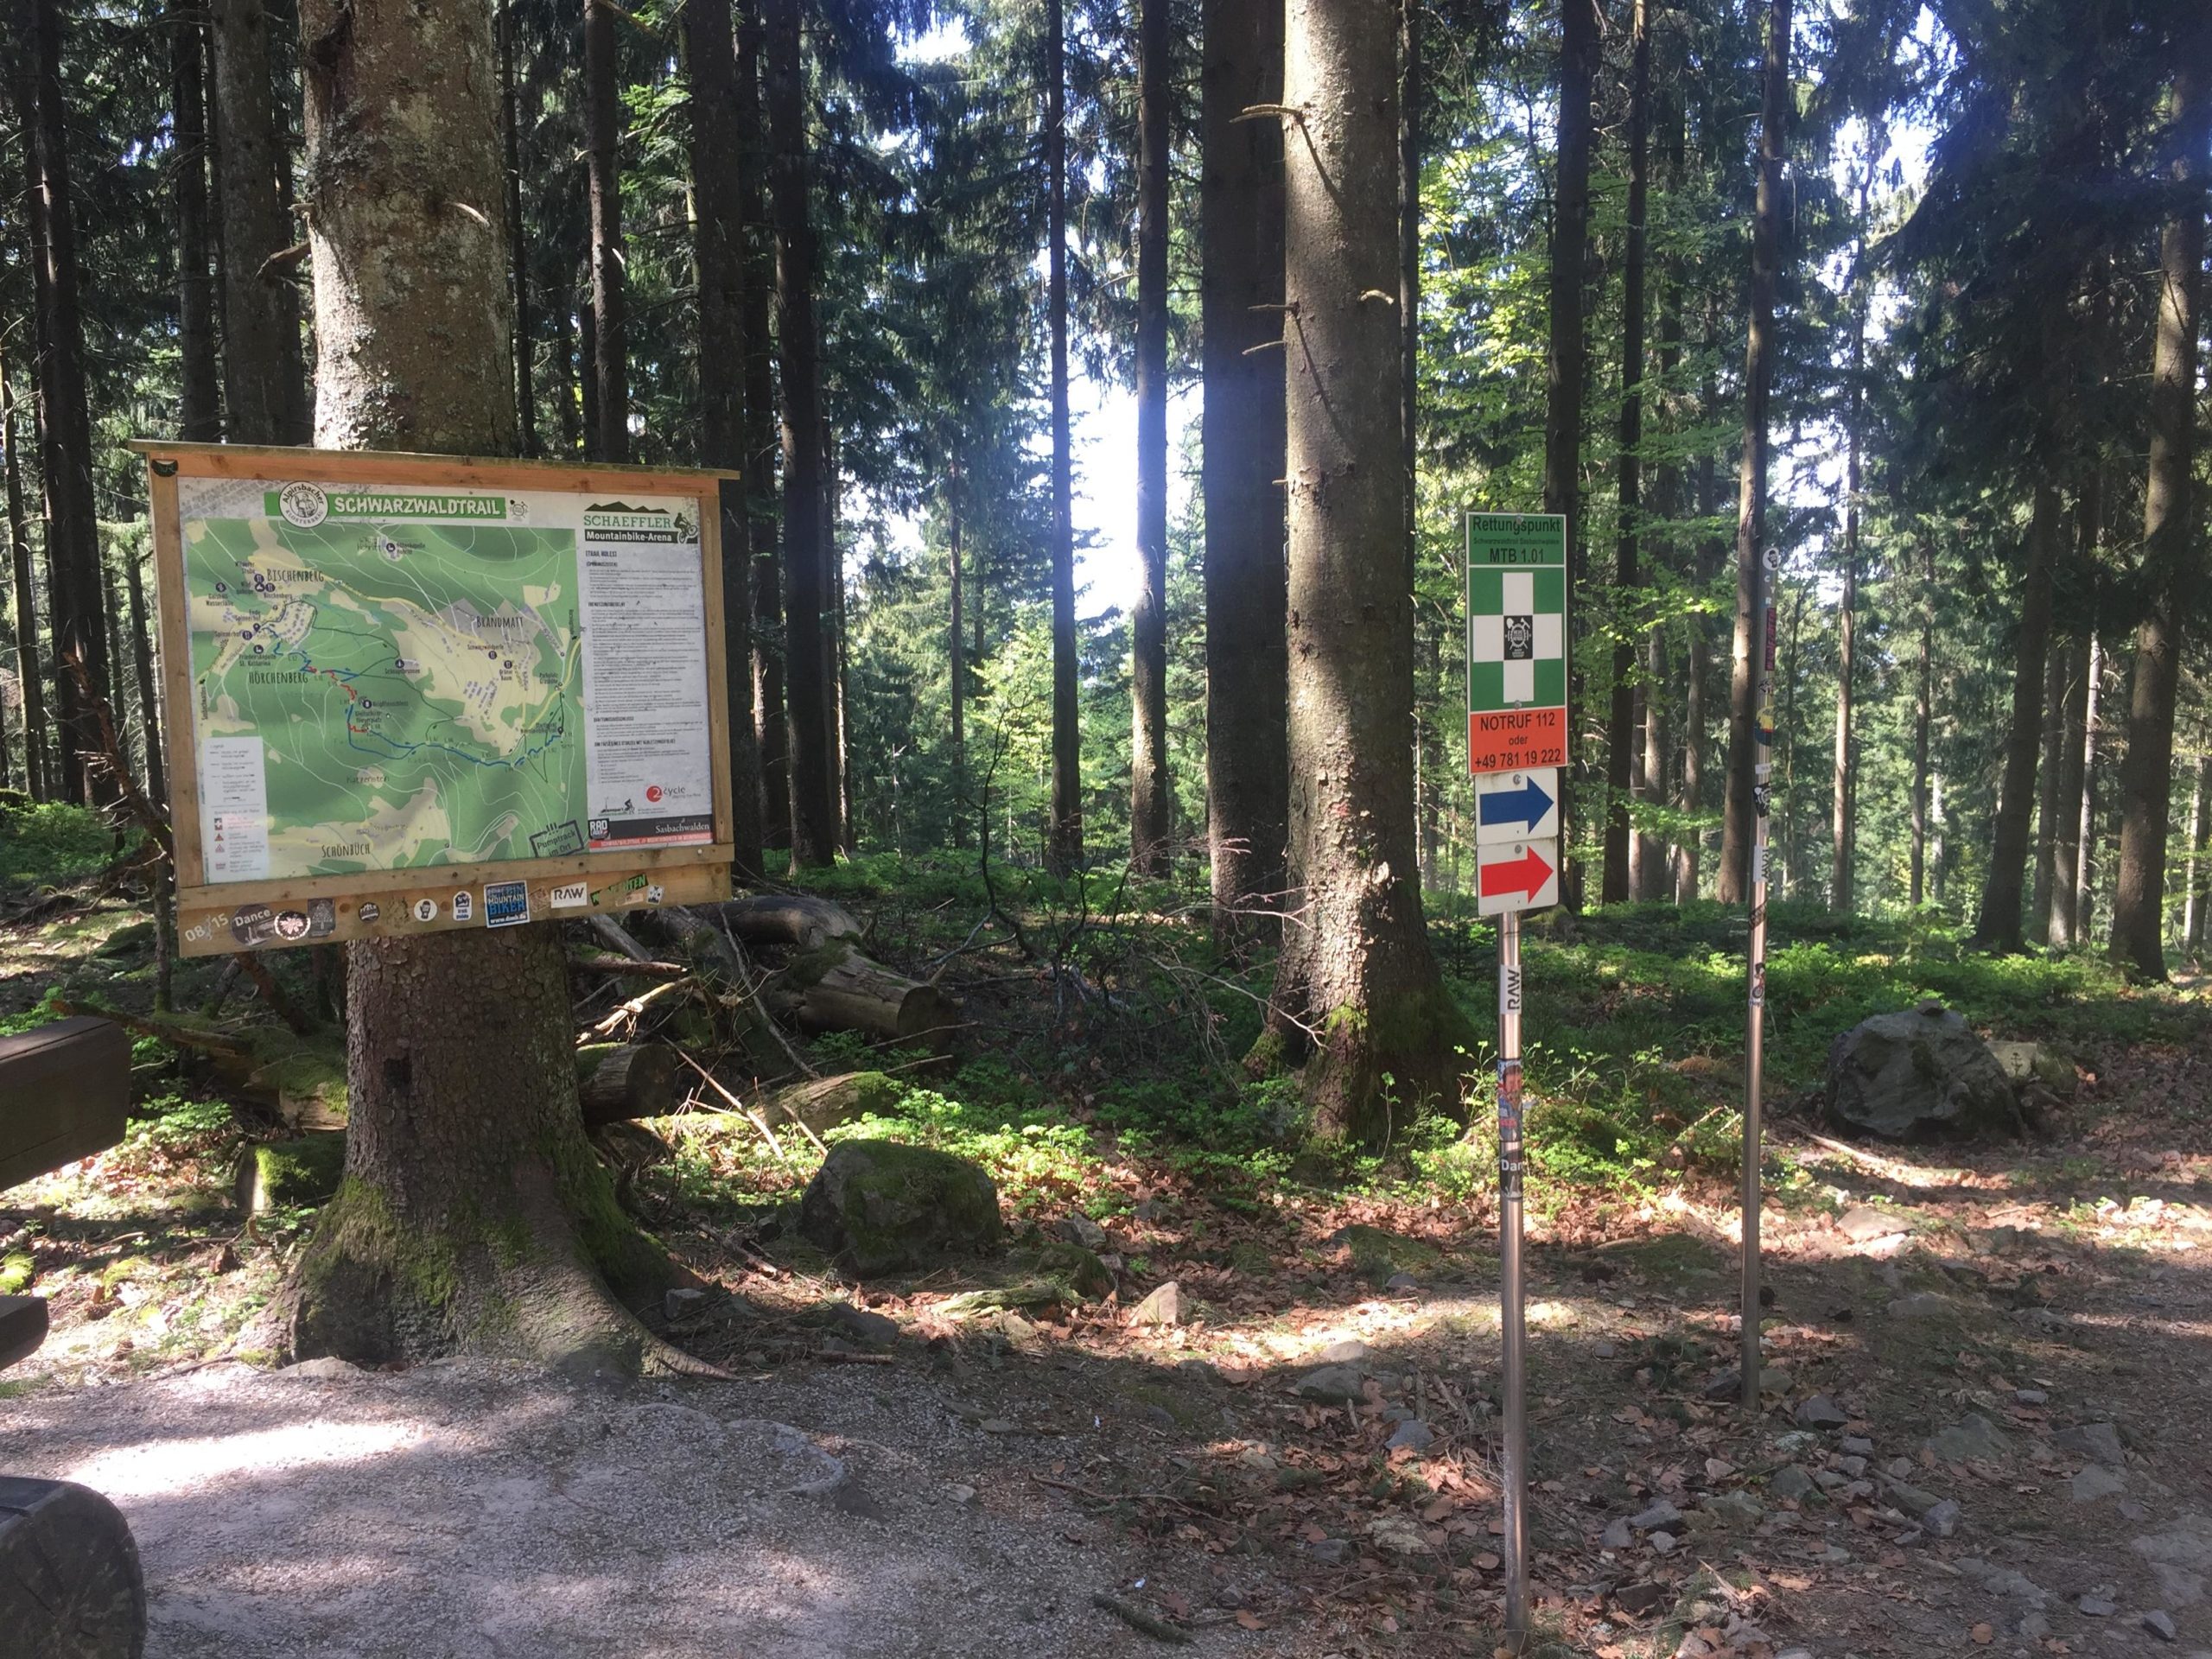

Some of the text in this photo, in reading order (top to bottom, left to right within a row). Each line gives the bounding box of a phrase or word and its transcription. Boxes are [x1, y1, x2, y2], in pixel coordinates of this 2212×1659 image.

[283, 484, 324, 505] Alpirsbacher
[334, 497, 500, 516] SCHWARZWALDTRAIL
[583, 515, 671, 529] SCHAEFFLER
[1472, 516, 1560, 535] Rettungspunkt
[587, 531, 672, 542] Mountainbike-Arena
[1490, 548, 1544, 563] MTB 1.01
[267, 569, 324, 582] BISCHENBERG
[476, 615, 524, 628] BRANDMATT
[248, 671, 308, 684] HÖRCHENBERG
[1480, 711, 1555, 731] NOTRUF 112
[1508, 735, 1528, 746] oder
[1475, 747, 1560, 768] +49 781 19 222
[589, 819, 608, 831] RAD
[655, 822, 709, 834] Sasbachwalden
[321, 842, 371, 858] SCHÖNBÜCH
[487, 893, 524, 905] MOUNTAIN
[554, 887, 585, 901] RAW
[489, 900, 525, 915] BIKER
[234, 909, 270, 927] Dance
[1507, 969, 1520, 1010] RAW
